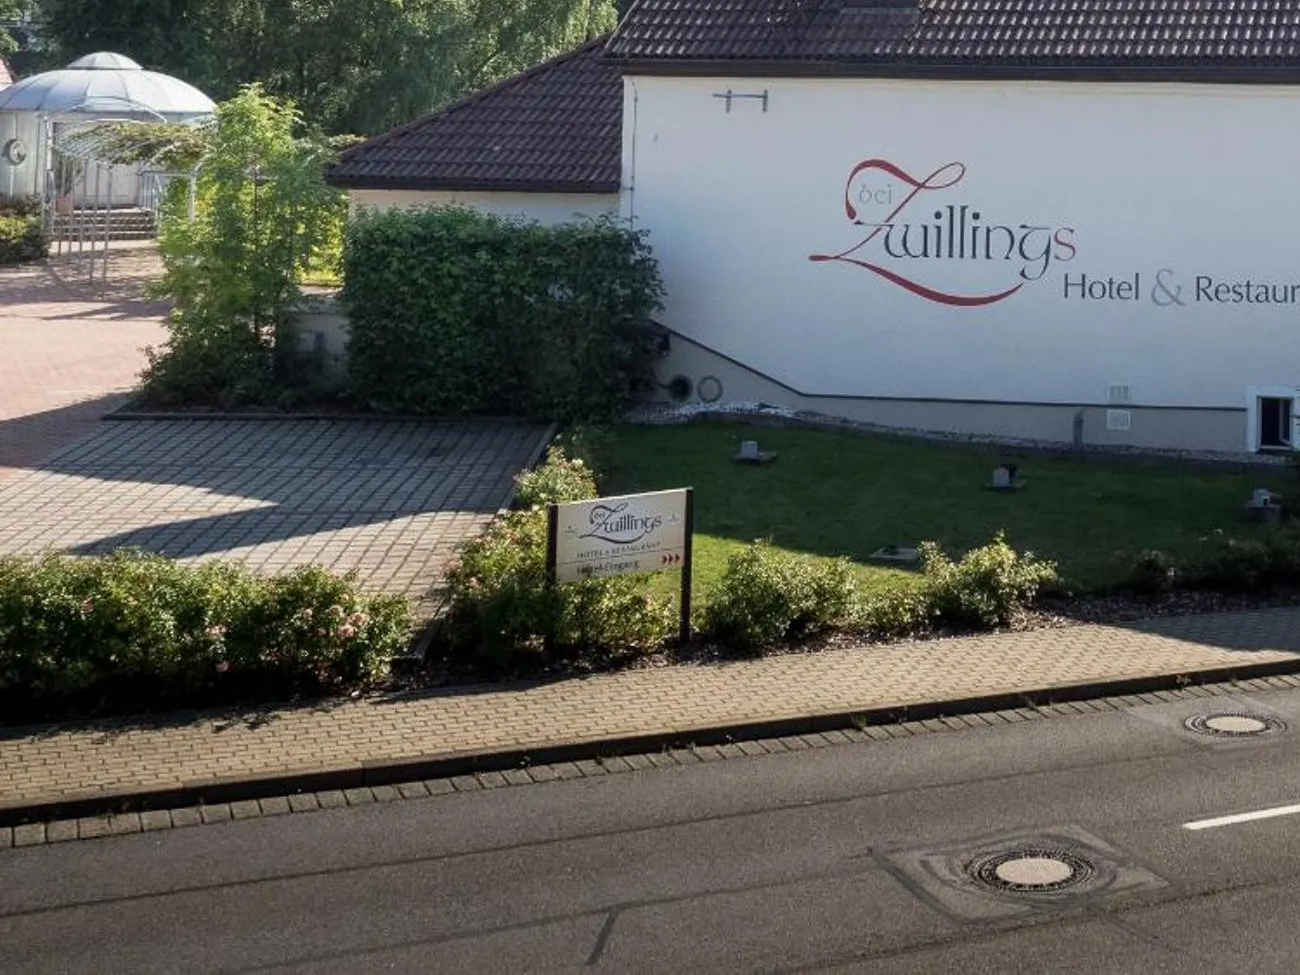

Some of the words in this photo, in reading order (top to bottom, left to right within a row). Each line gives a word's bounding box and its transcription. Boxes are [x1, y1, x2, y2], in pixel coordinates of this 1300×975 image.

[809, 159, 1077, 306] Zwillings
[1063, 272, 1140, 300] Hotel
[1150, 268, 1186, 306] &
